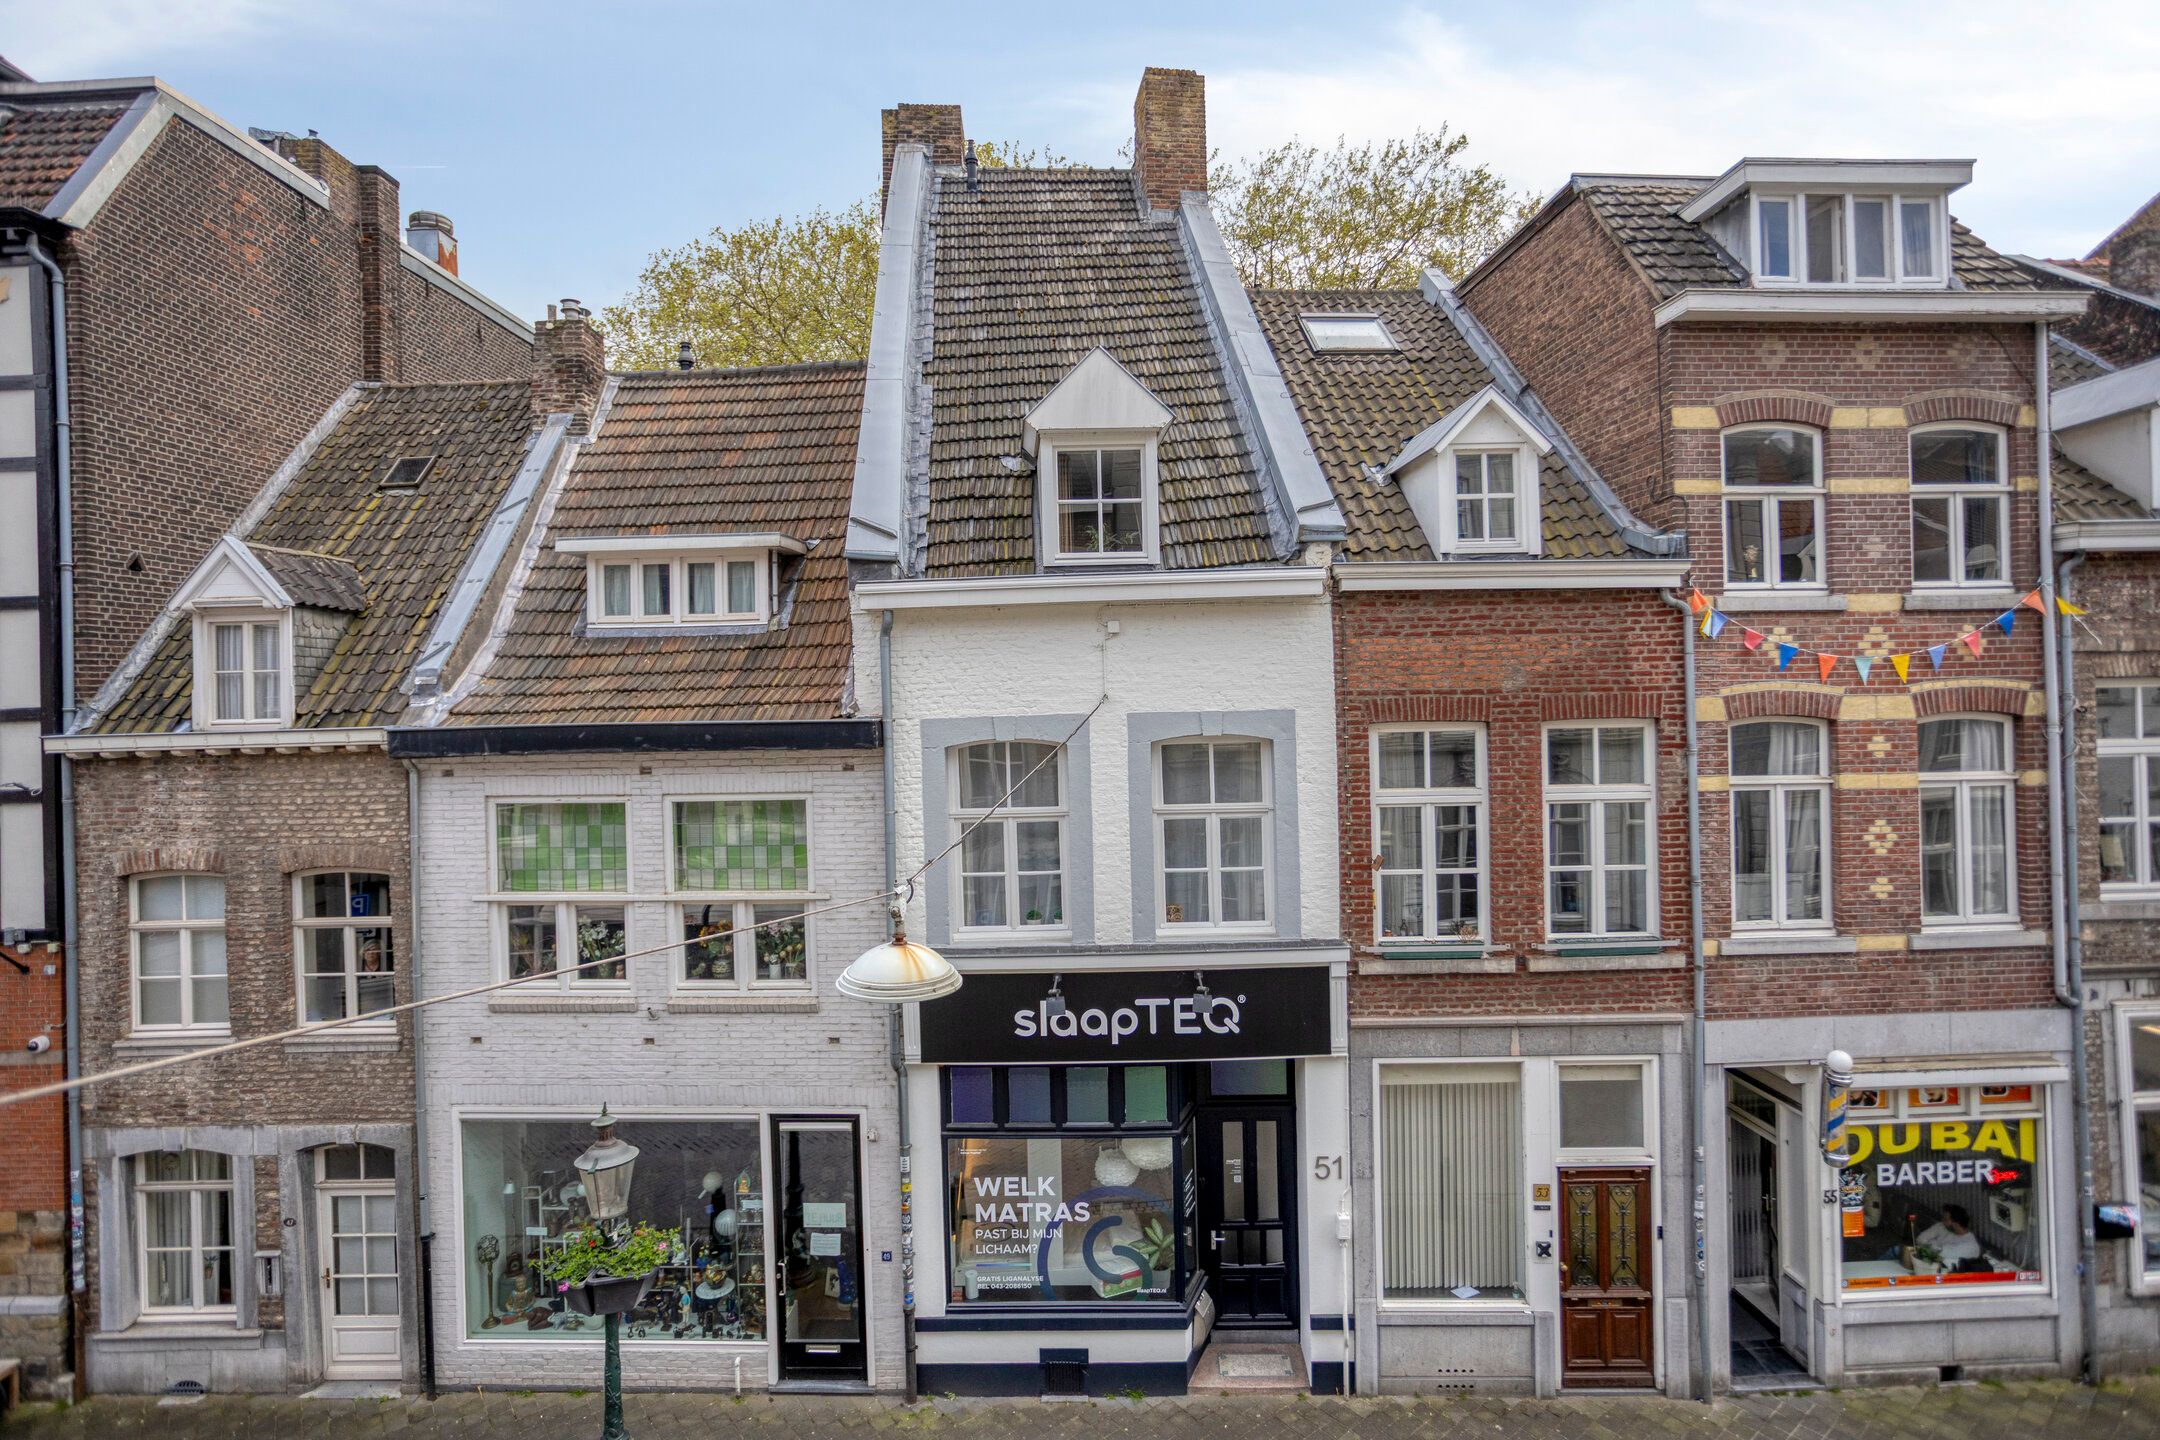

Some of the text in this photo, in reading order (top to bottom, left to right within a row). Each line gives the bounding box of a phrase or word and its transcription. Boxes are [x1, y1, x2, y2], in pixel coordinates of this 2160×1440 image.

[1315, 1155, 1342, 1180] 51
[1877, 1159, 1994, 1187] BARBER
[974, 1177, 1056, 1197] WELK
[1536, 1187, 1549, 1198] 53
[1823, 1190, 1838, 1204] 55
[975, 1202, 1091, 1223] MATRAS
[975, 1228, 1062, 1239] PAST BIJ MIJN
[975, 1243, 1038, 1254] LICHAAM?
